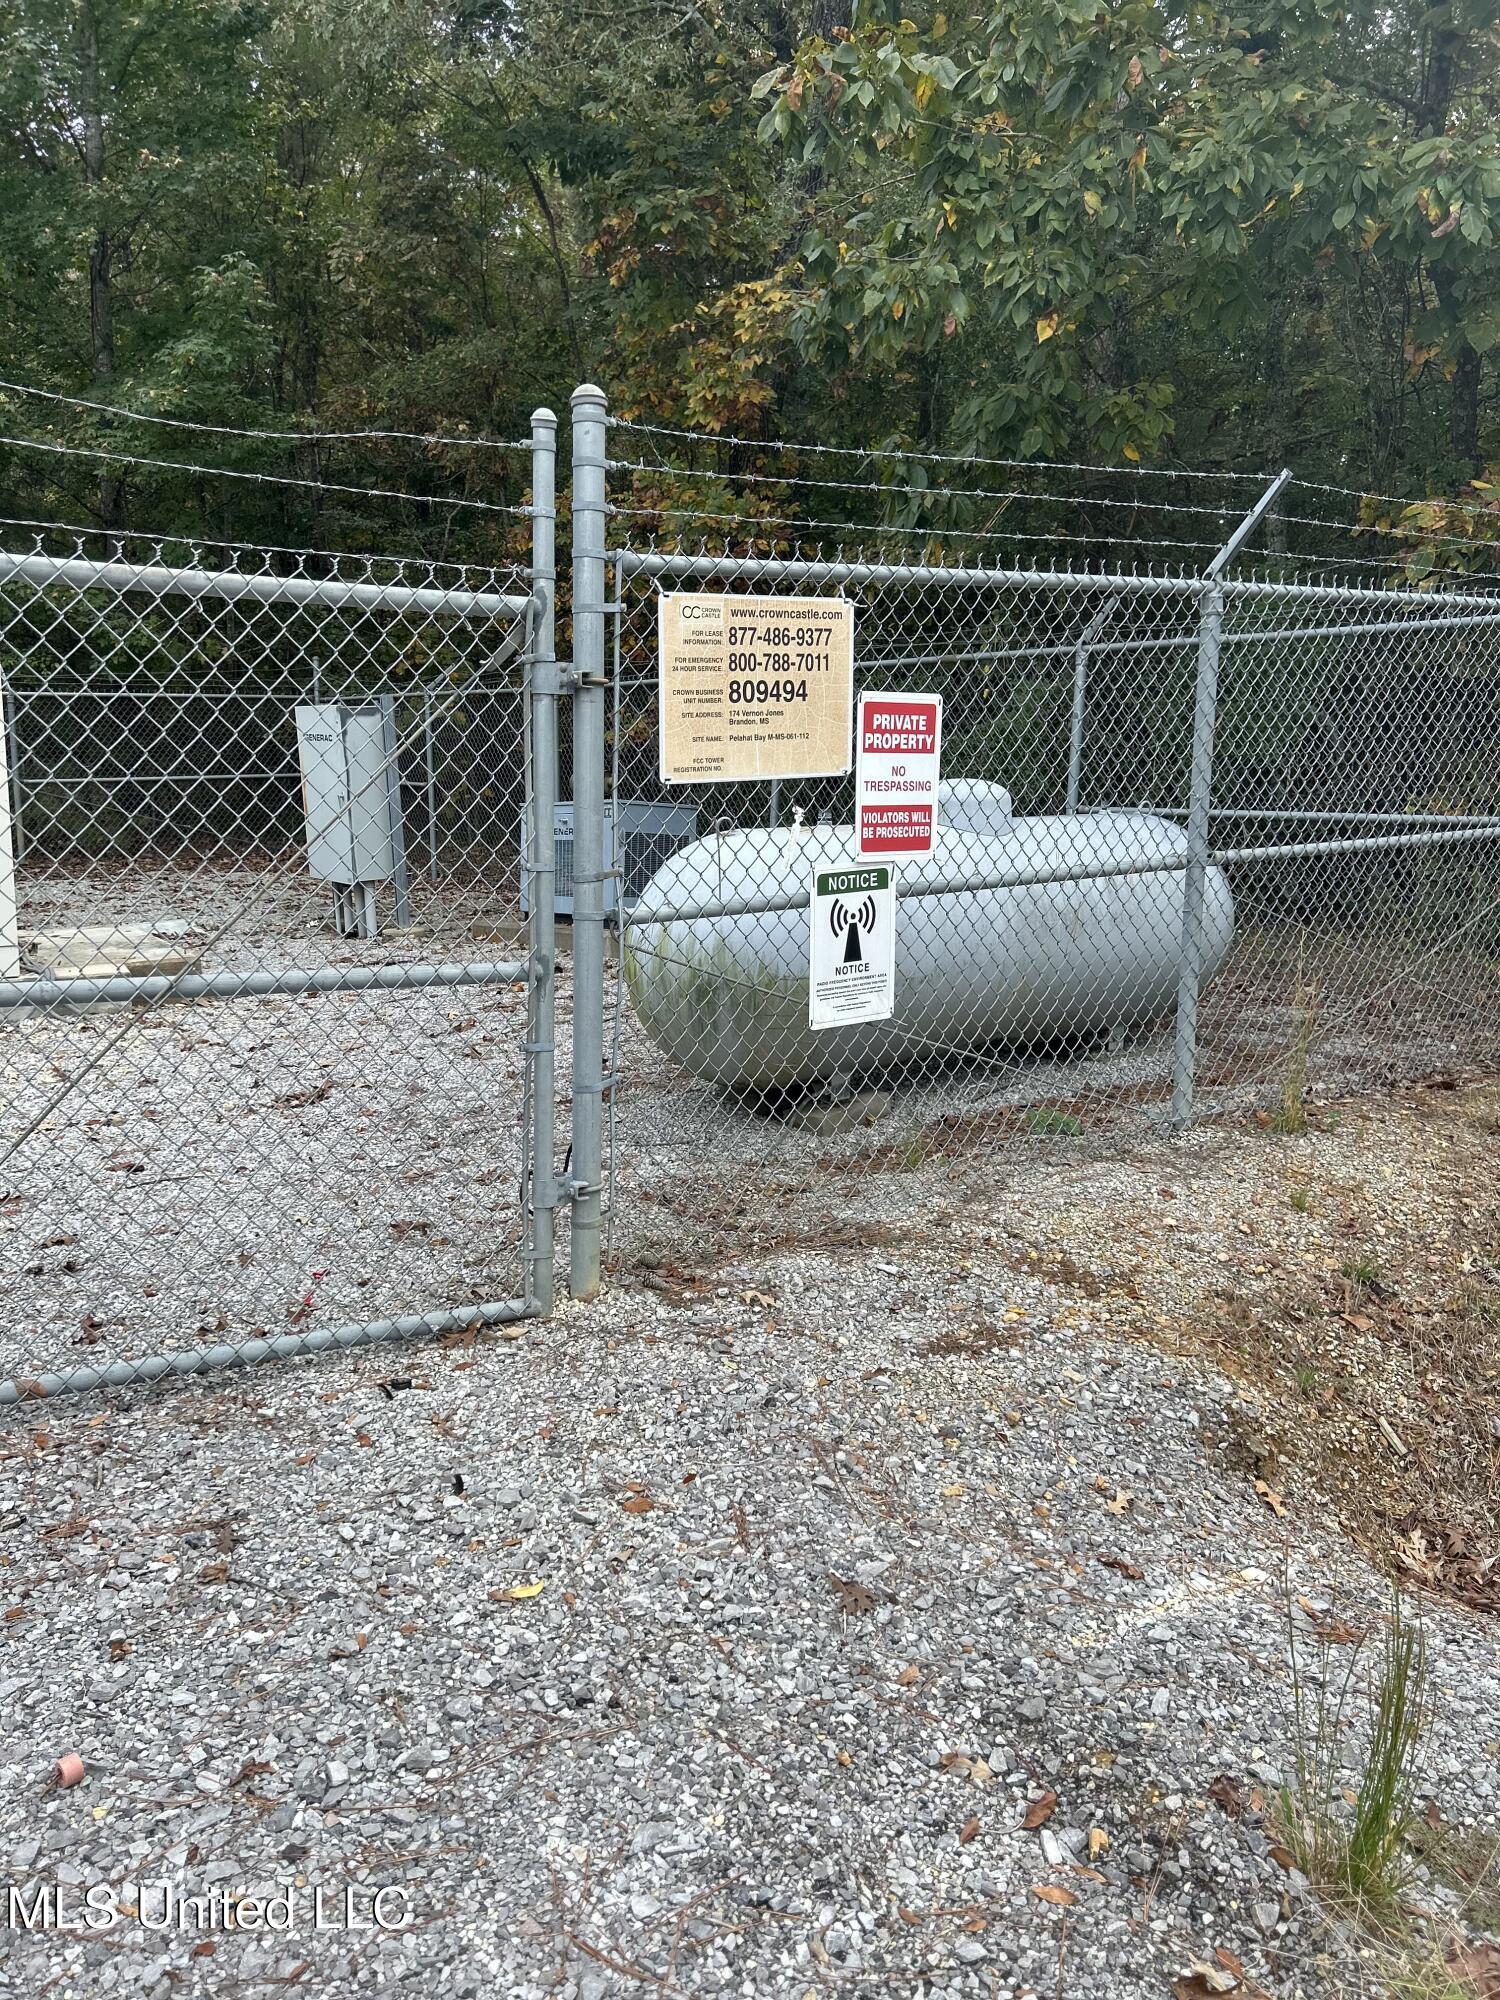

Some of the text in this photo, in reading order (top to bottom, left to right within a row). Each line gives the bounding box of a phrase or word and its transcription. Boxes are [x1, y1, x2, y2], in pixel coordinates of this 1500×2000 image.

[730, 608, 843, 620] www.crowncastle.com
[728, 626, 832, 646] 877-486-9377
[728, 652, 829, 672] 800-788-7011
[728, 680, 808, 704] 809494
[764, 709, 784, 717] Jones
[759, 717, 770, 725] MS
[872, 713, 928, 731] PRIVATE
[729, 732, 810, 742] Pelahat Bay M-MS-061-112
[864, 732, 934, 750] PROPERTY
[891, 765, 906, 777] NO
[863, 780, 932, 792] TRESPASSING
[862, 811, 931, 824] VIOLATORS WILL
[553, 827, 574, 836] ENER
[862, 825, 931, 839] BE PROSECUTED
[828, 872, 879, 891] NOTICE
[835, 962, 870, 977] NOTICE
